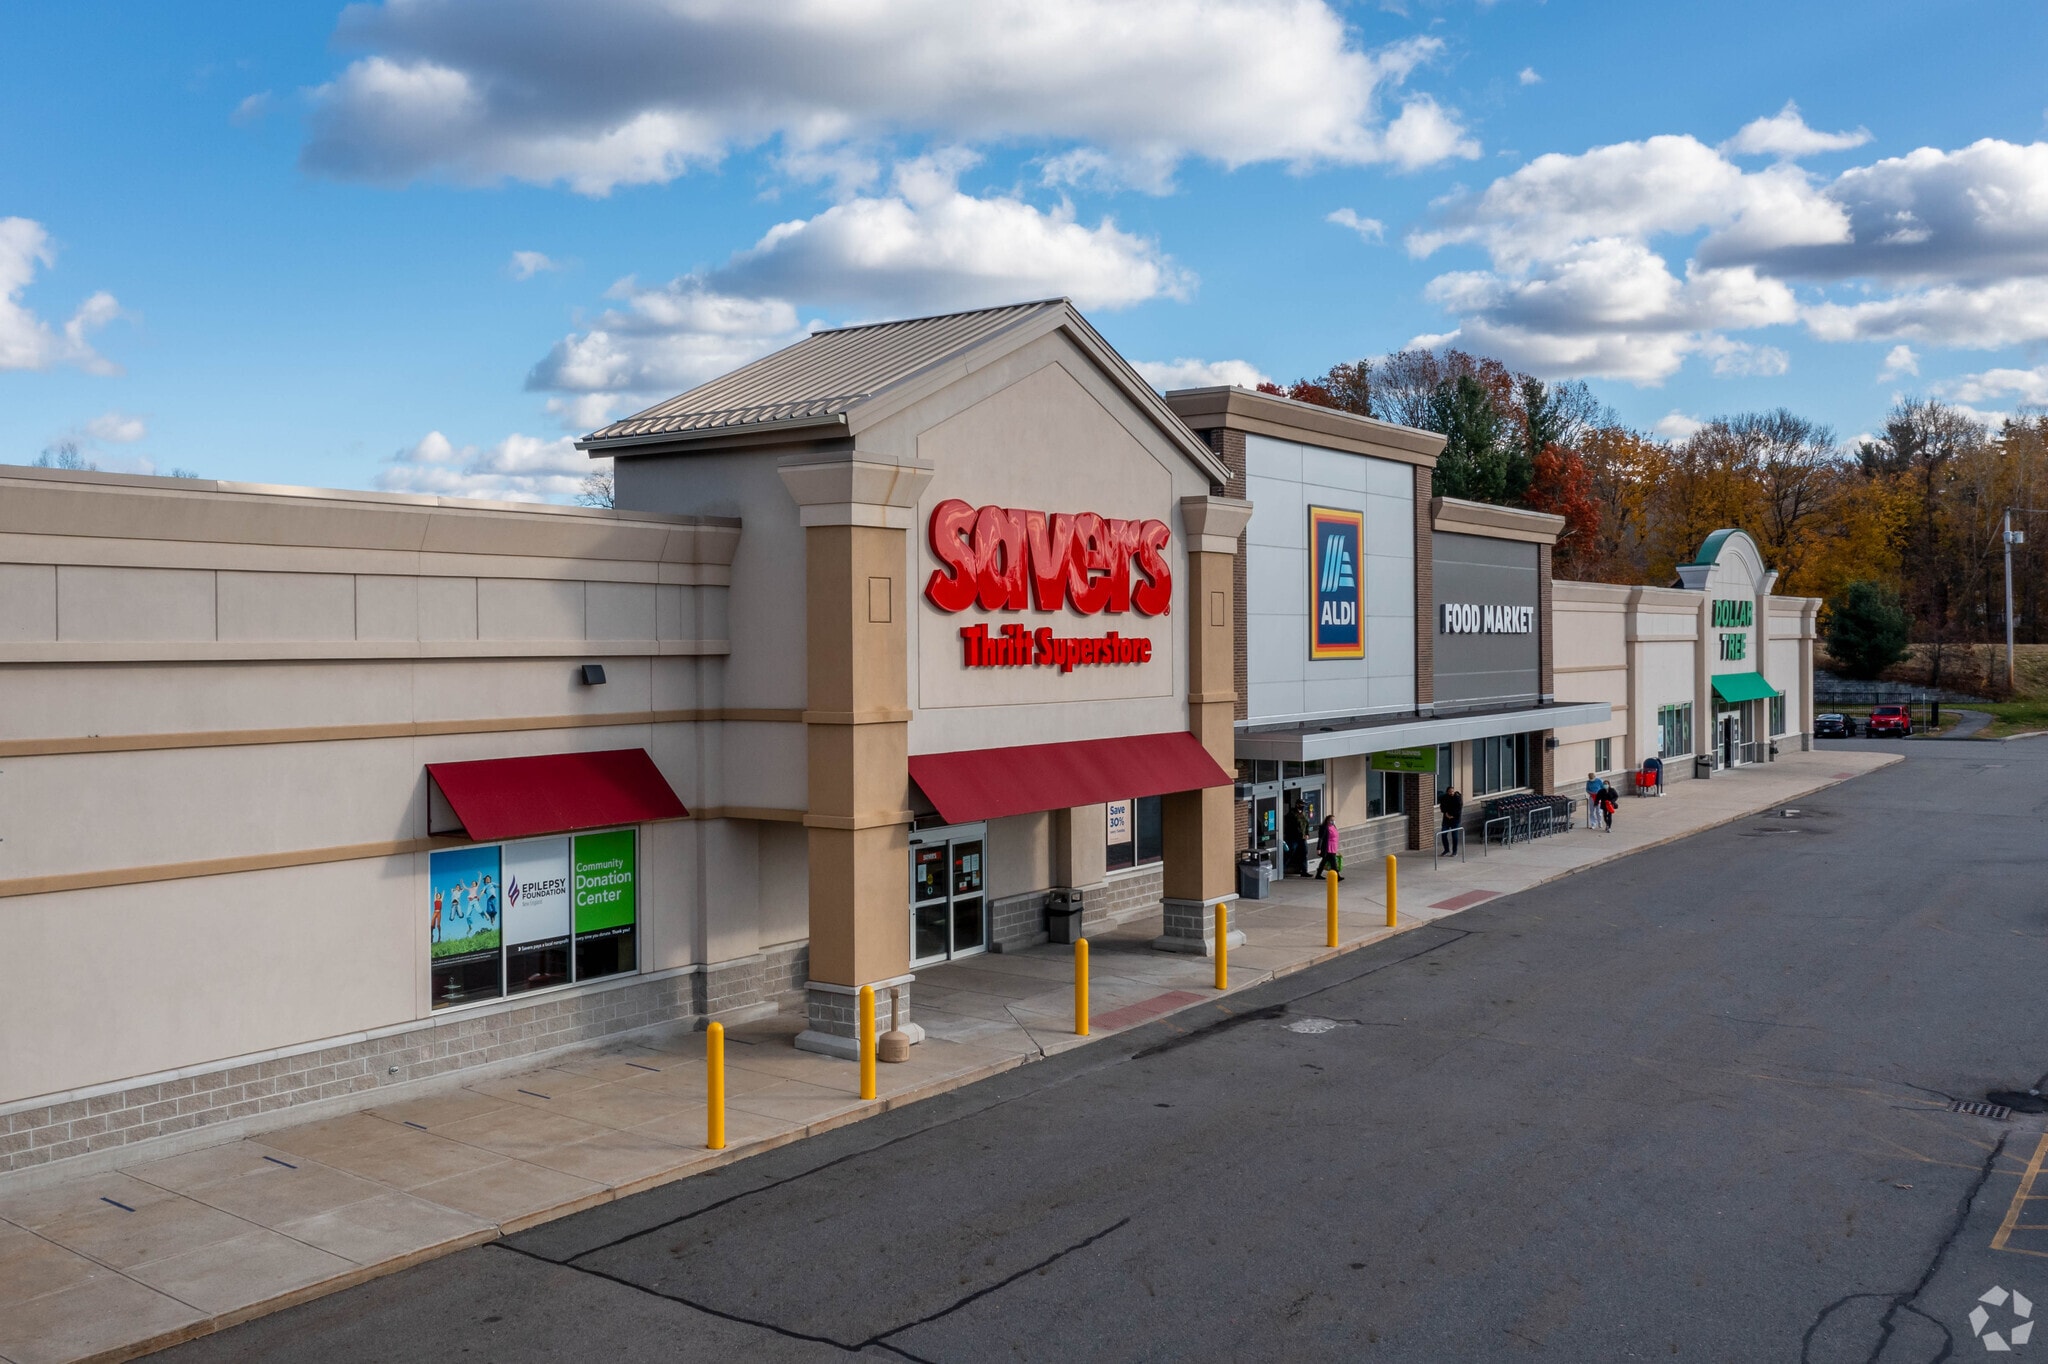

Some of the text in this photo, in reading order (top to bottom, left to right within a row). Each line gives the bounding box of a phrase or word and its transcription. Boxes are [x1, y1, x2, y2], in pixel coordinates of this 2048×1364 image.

[1320, 600, 1356, 626] ALDI
[1441, 603, 1534, 634] FOOD MARKET
[1712, 599, 1753, 628] DOLLAR
[960, 623, 1152, 673] Thrift Superstore
[1719, 632, 1747, 661] TREE
[1110, 805, 1125, 815] Save
[1110, 817, 1125, 827] 30%
[576, 858, 623, 872] Community
[522, 878, 566, 893] EPILEPSY
[576, 870, 631, 890] Donation
[522, 888, 566, 900] FOUNDATION
[577, 890, 622, 906] Center
